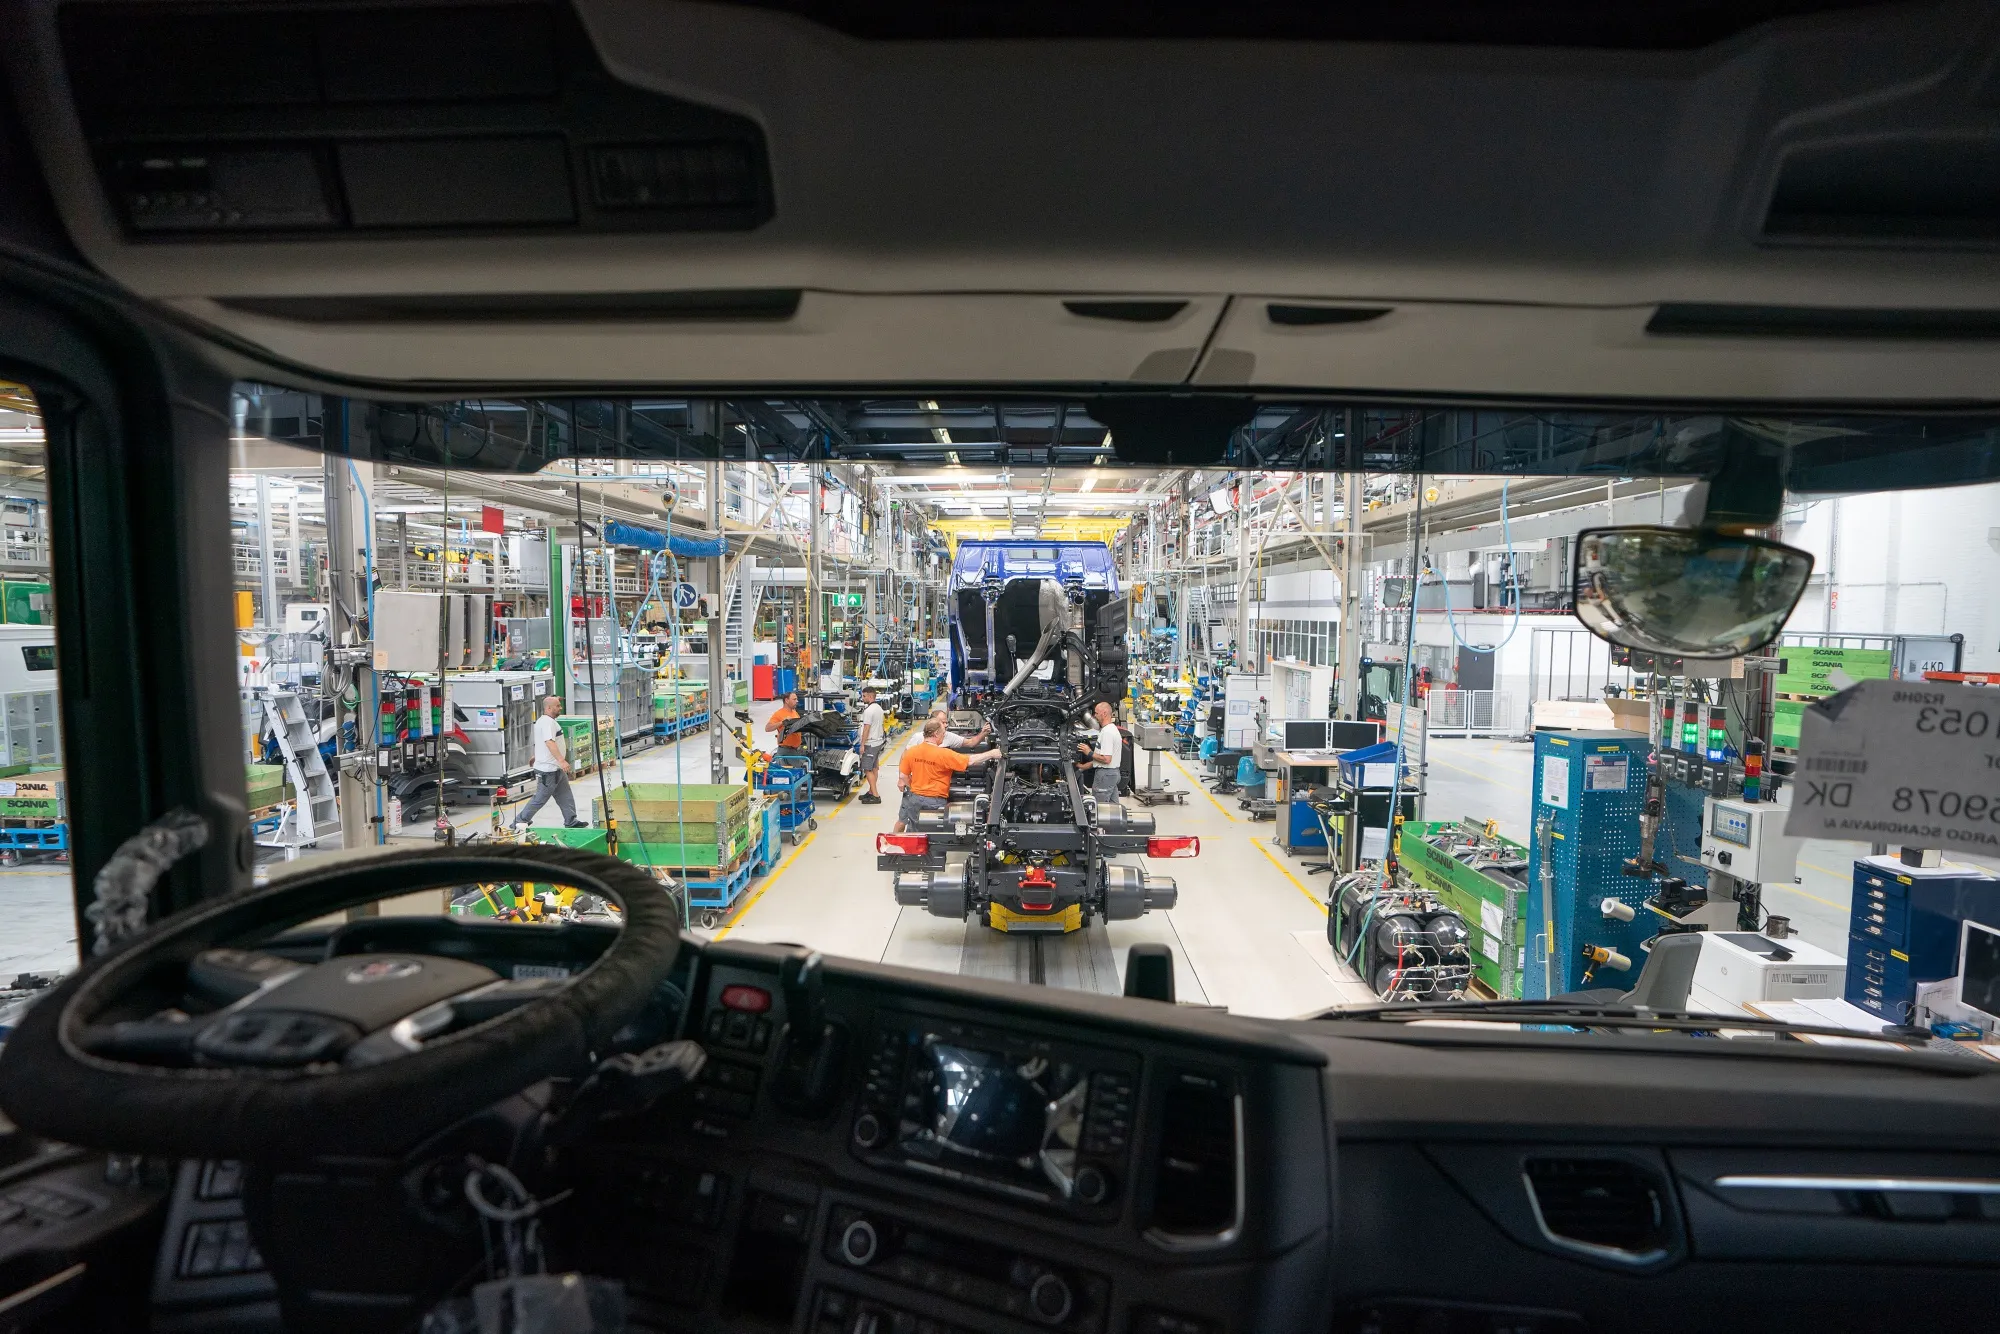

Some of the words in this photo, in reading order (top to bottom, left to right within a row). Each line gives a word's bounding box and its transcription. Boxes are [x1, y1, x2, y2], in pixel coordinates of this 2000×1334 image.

[1831, 591, 1839, 600] R
[1831, 601, 1837, 610] 5
[1812, 649, 1844, 657] SCANIA
[1811, 660, 1843, 668] SCANIA
[1921, 661, 1929, 672] 4
[1930, 661, 1944, 672] KD
[16, 782, 49, 791] CANIA
[7, 799, 50, 808] SCANIA
[1426, 847, 1454, 872] SCANIA
[1425, 870, 1453, 896] SCANIA
